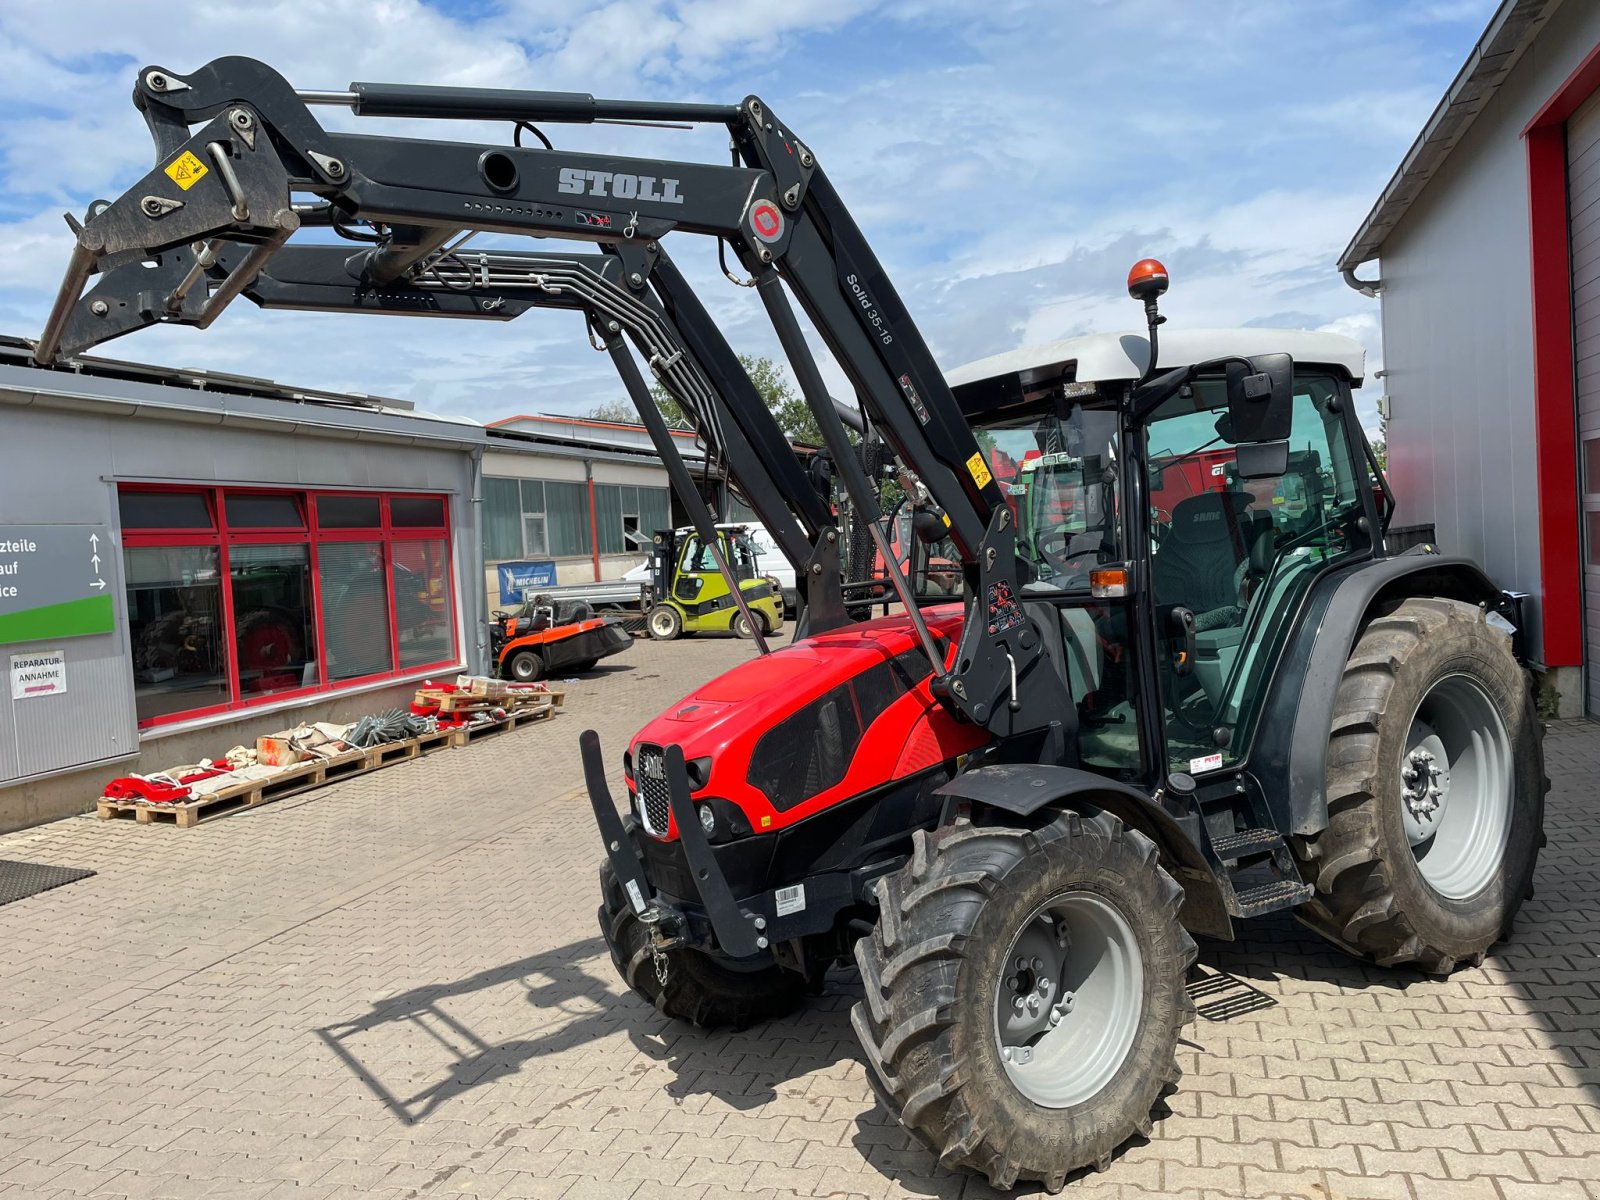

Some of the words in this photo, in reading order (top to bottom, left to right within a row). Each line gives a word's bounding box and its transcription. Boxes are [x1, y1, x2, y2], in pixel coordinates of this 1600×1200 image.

[558, 167, 684, 204] STOLL
[847, 274, 872, 309] Solid
[868, 310, 893, 345] 35-18
[0, 539, 37, 552] zteile
[515, 575, 549, 587] MICHELIN
[13, 657, 63, 670] REPARATUR-
[19, 670, 60, 682] ANNAHME
